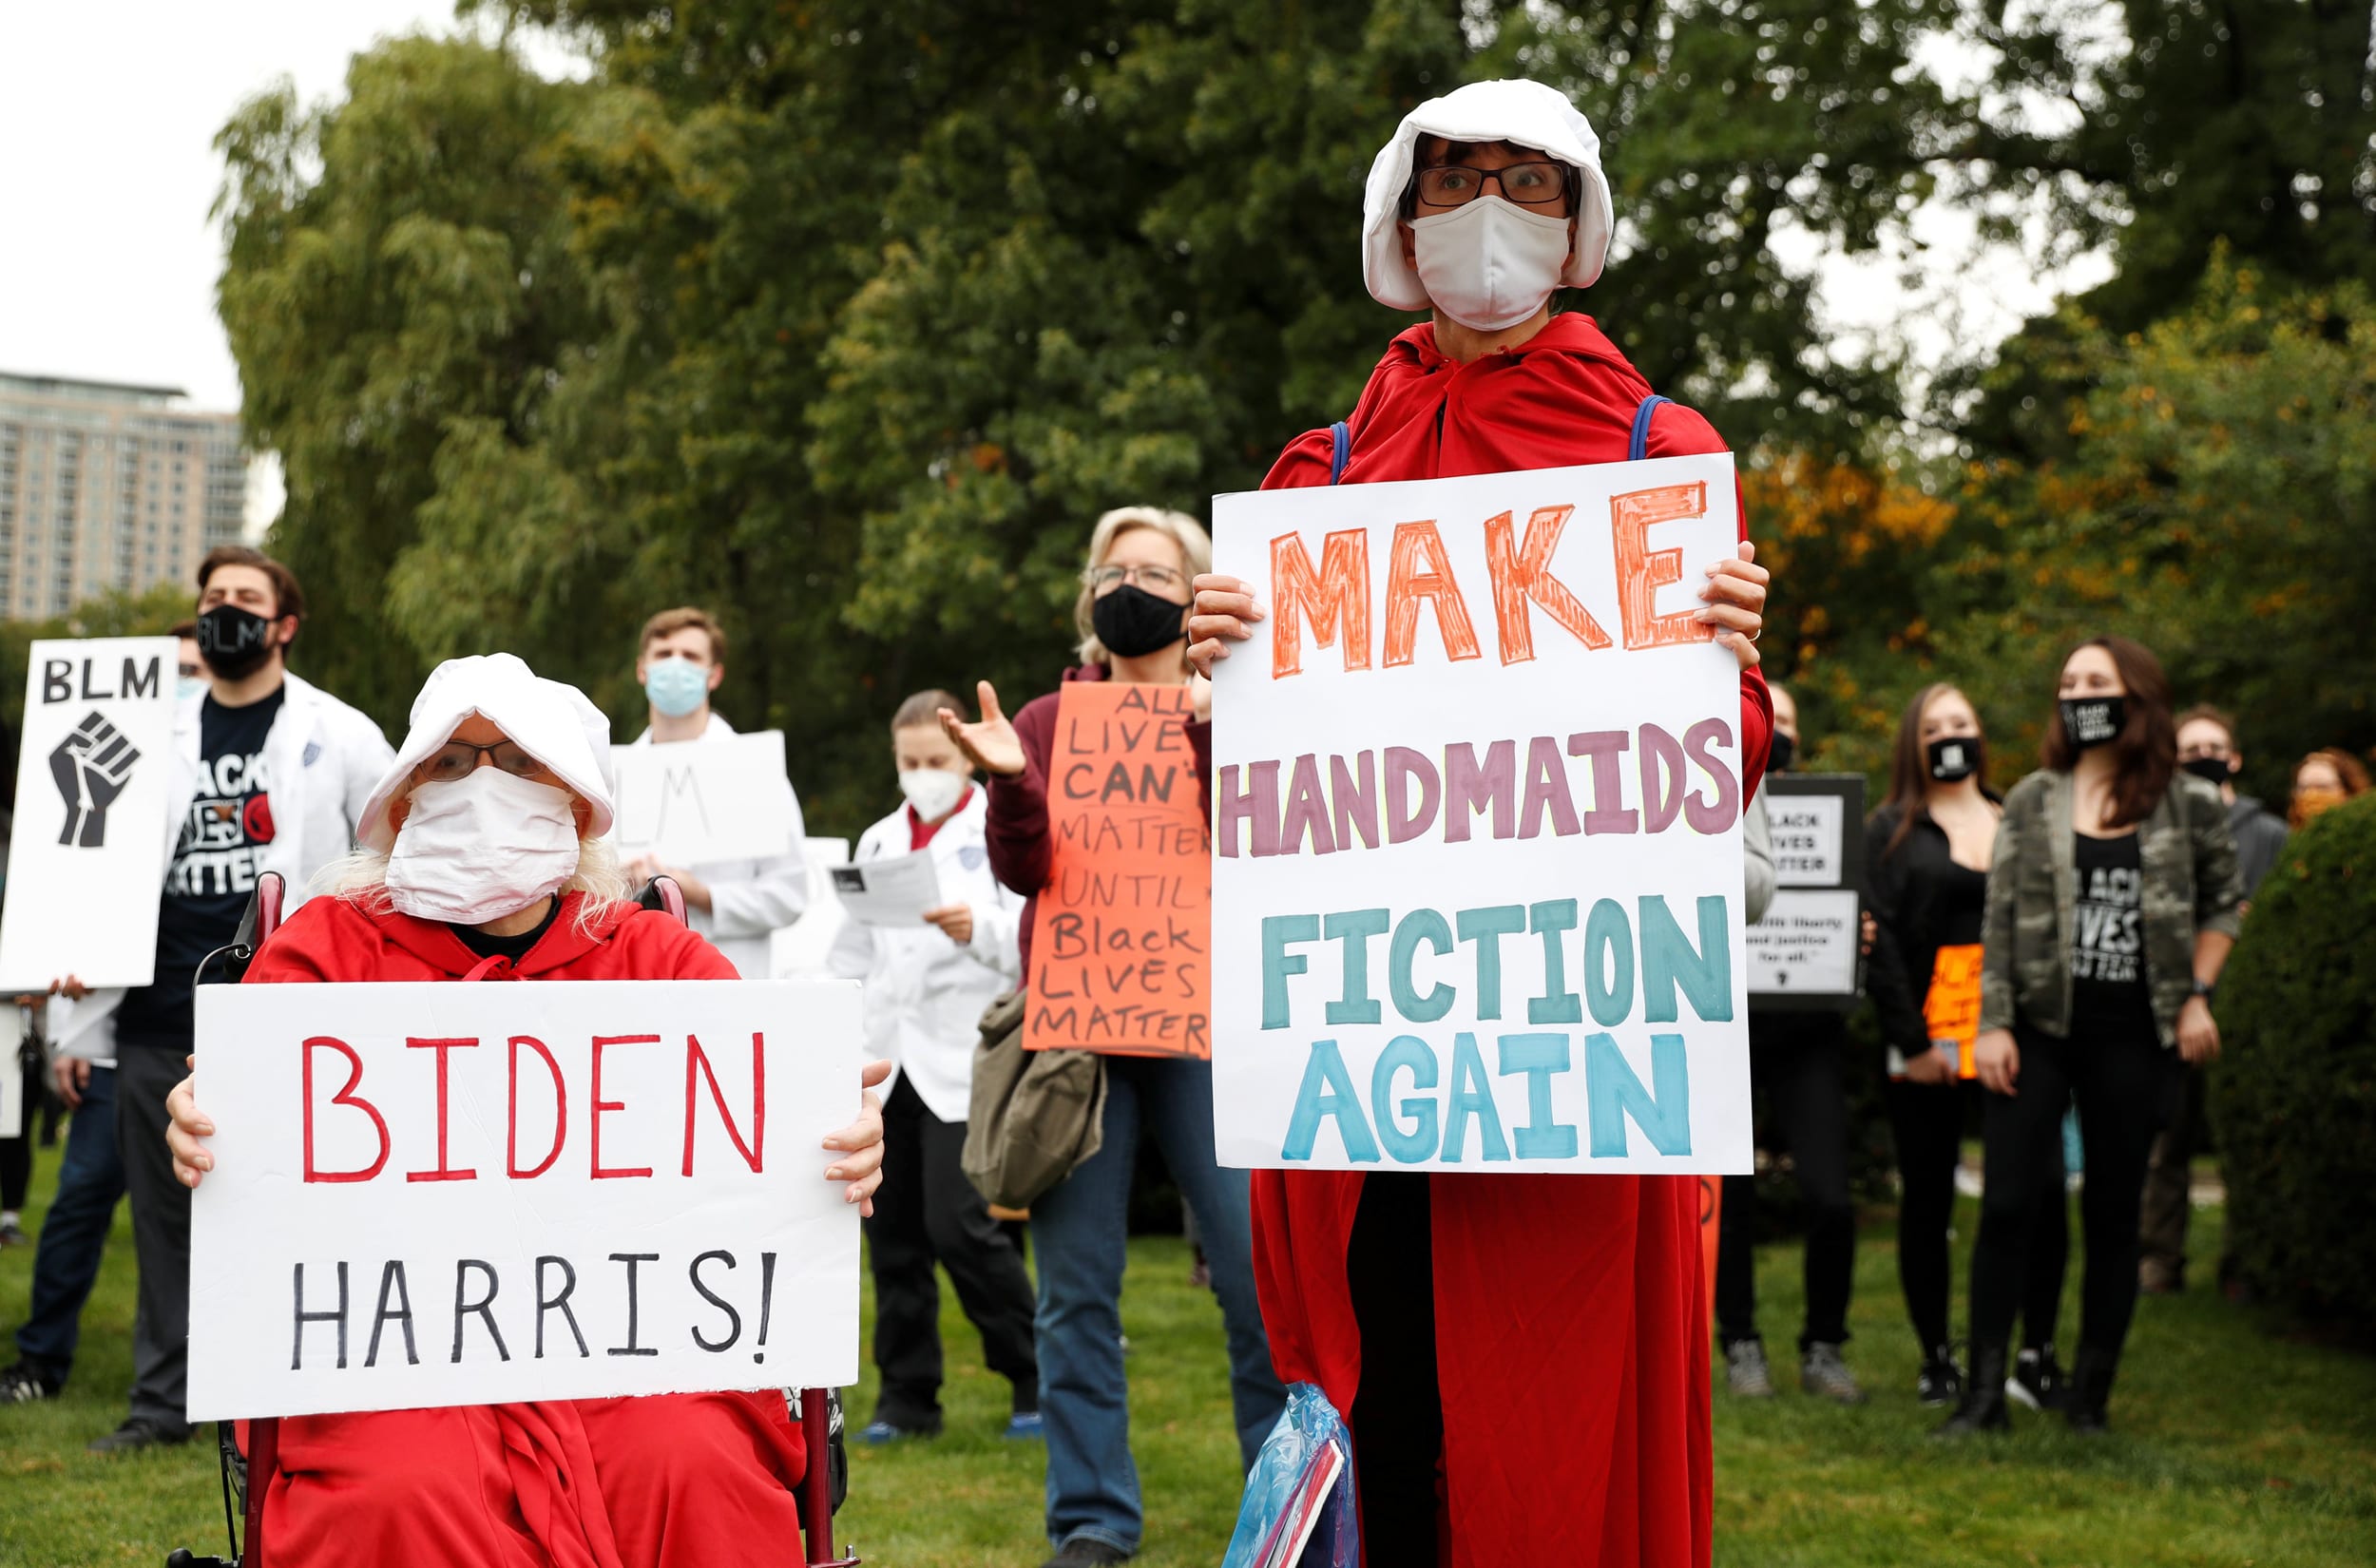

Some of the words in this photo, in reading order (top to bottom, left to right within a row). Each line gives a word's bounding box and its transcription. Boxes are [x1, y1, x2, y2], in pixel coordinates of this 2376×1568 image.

[1270, 480, 1715, 679] MAKE
[197, 619, 266, 654] BLM
[44, 656, 160, 704] BLM
[1116, 686, 1195, 715] ALL
[1068, 717, 1183, 755] LIVE
[195, 754, 270, 797] ACK
[1217, 717, 1739, 858] HANDMAIDS
[615, 764, 715, 848] LM
[1768, 813, 1820, 829] LACK
[1061, 867, 1196, 908] UNTIL
[1049, 912, 1203, 960] Black
[1040, 959, 1196, 999] LIVES
[1260, 895, 1733, 1029] FICTION
[1032, 1004, 1208, 1052] MATTER
[302, 1032, 764, 1183] BIDEN
[1281, 1032, 1692, 1162] AGAIN
[291, 1250, 776, 1369] HARRIS!
